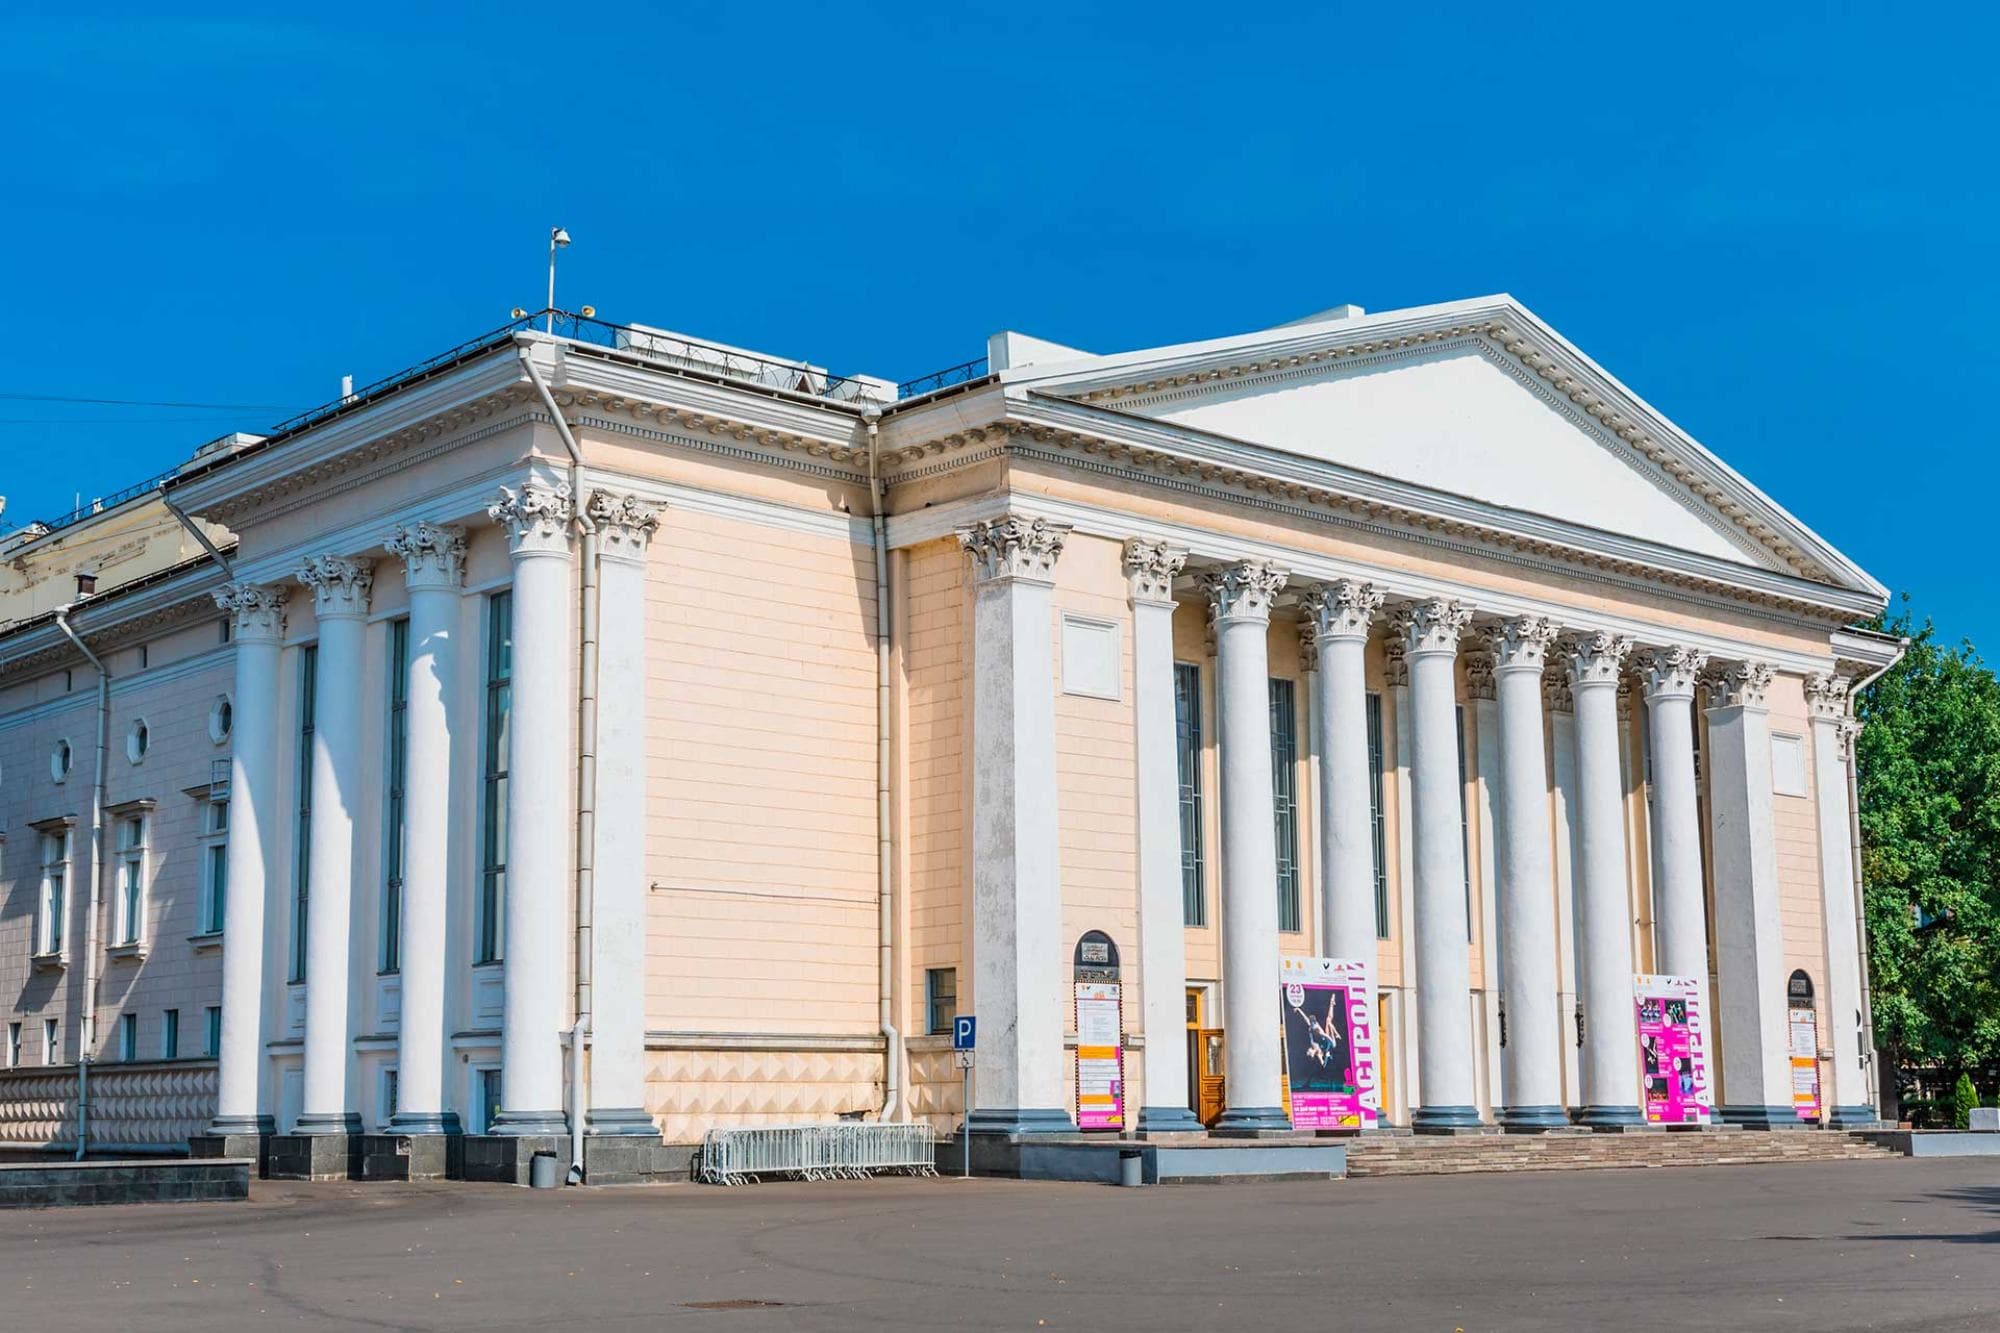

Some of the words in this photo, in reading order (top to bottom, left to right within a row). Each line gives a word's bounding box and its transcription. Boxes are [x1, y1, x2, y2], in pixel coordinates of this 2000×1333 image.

[1290, 984, 1301, 994] 23
[958, 1019, 972, 1047] P
[1345, 962, 1378, 1129] ГАСТРОЛИ
[1684, 980, 1711, 1124] ГАСТРОЛИ
